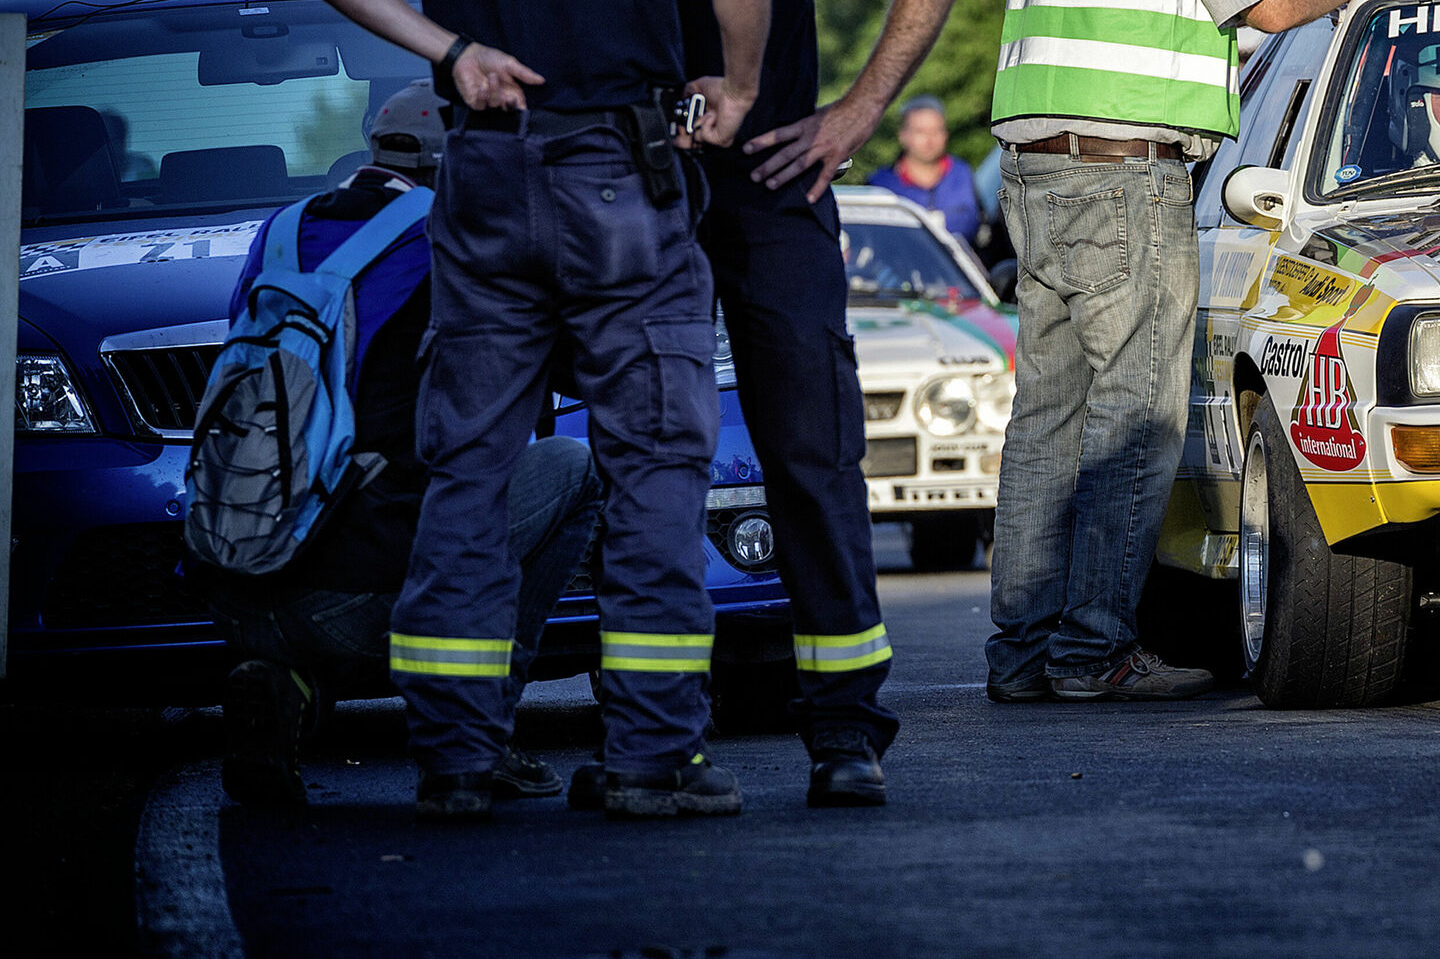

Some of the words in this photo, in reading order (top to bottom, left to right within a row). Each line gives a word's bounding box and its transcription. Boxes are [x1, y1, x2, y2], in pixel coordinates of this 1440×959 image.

[1316, 277, 1350, 307] Sport
[1260, 335, 1309, 379] Castrol
[1306, 352, 1348, 430] HB
[1299, 433, 1357, 460] international
